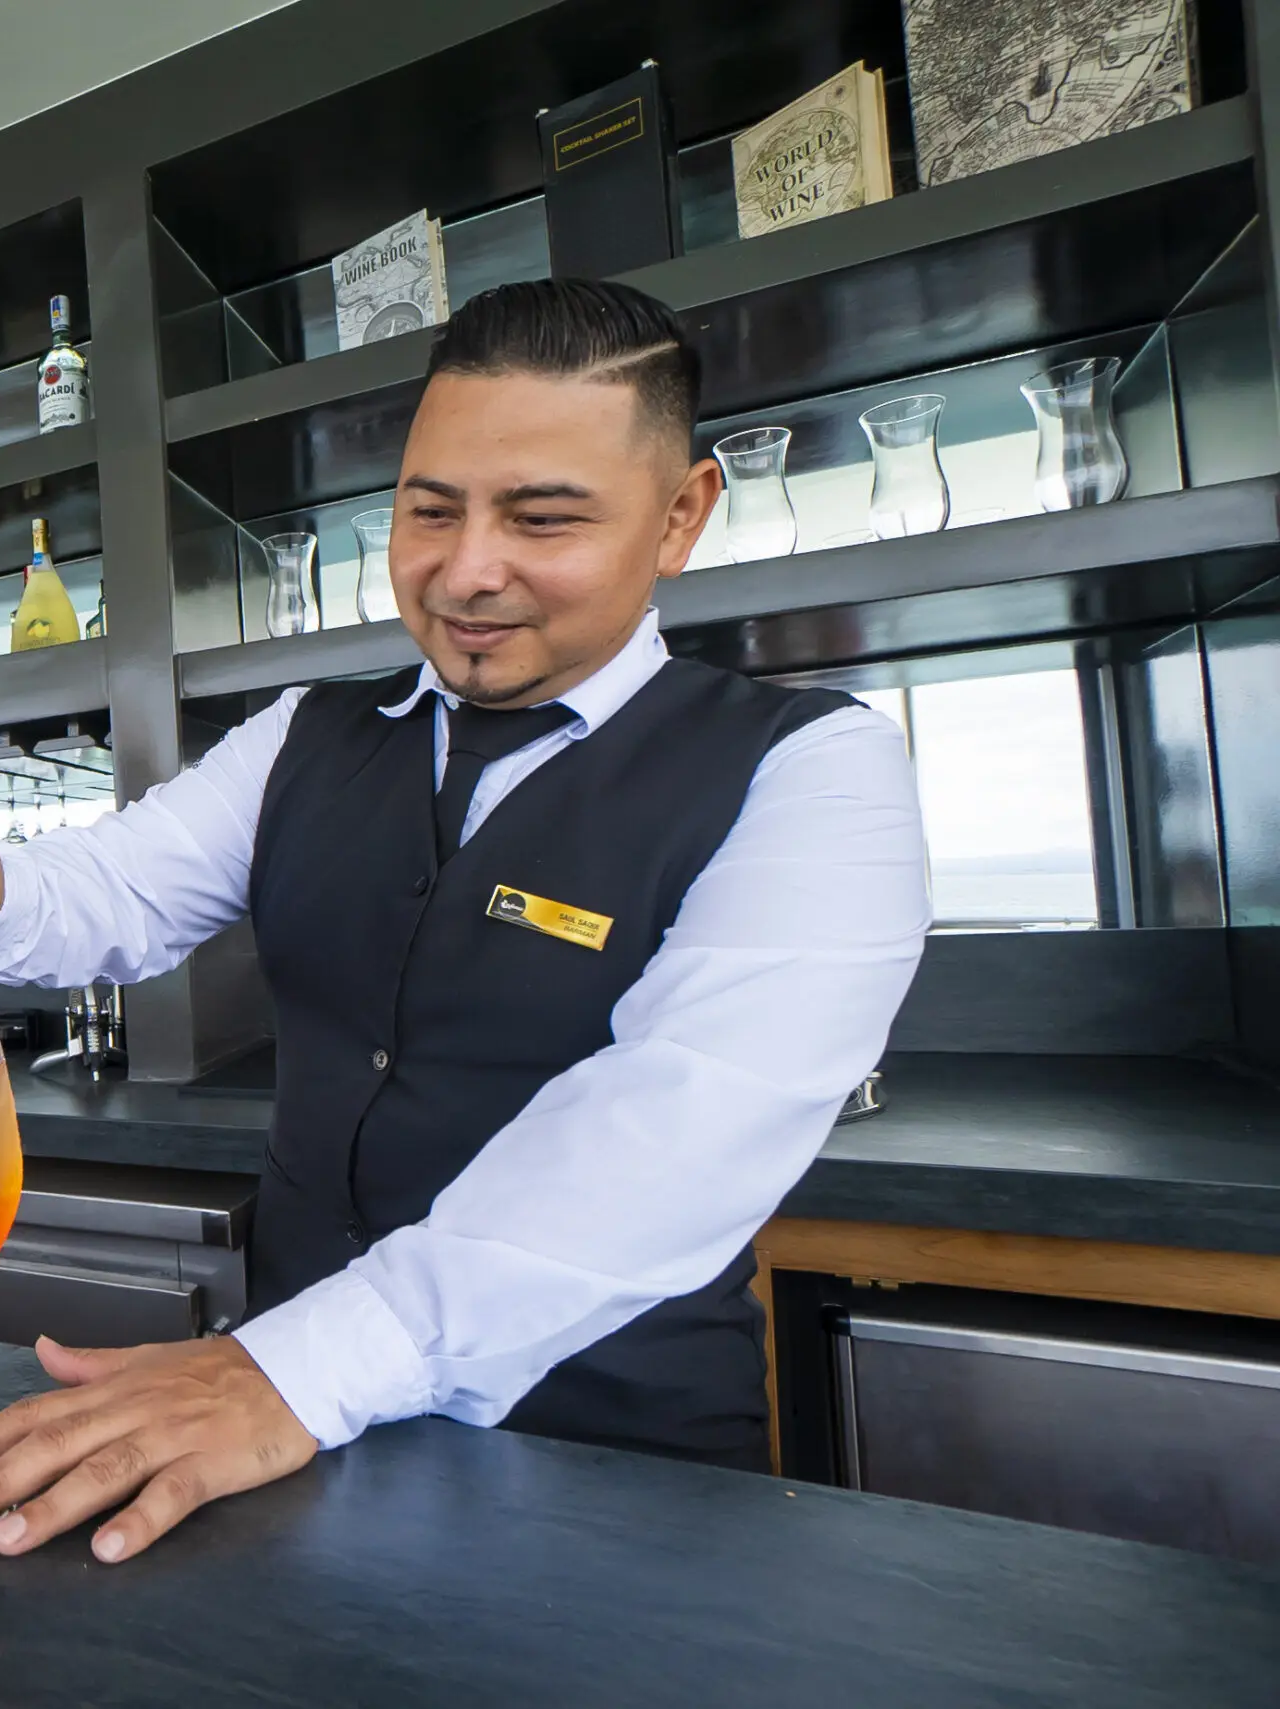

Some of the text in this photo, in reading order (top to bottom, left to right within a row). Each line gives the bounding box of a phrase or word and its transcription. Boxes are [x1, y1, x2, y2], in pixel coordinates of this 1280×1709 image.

[754, 129, 834, 184] WORLD
[781, 165, 810, 193] OF
[769, 181, 826, 223] WINE
[344, 236, 418, 286] WINE BOOK
